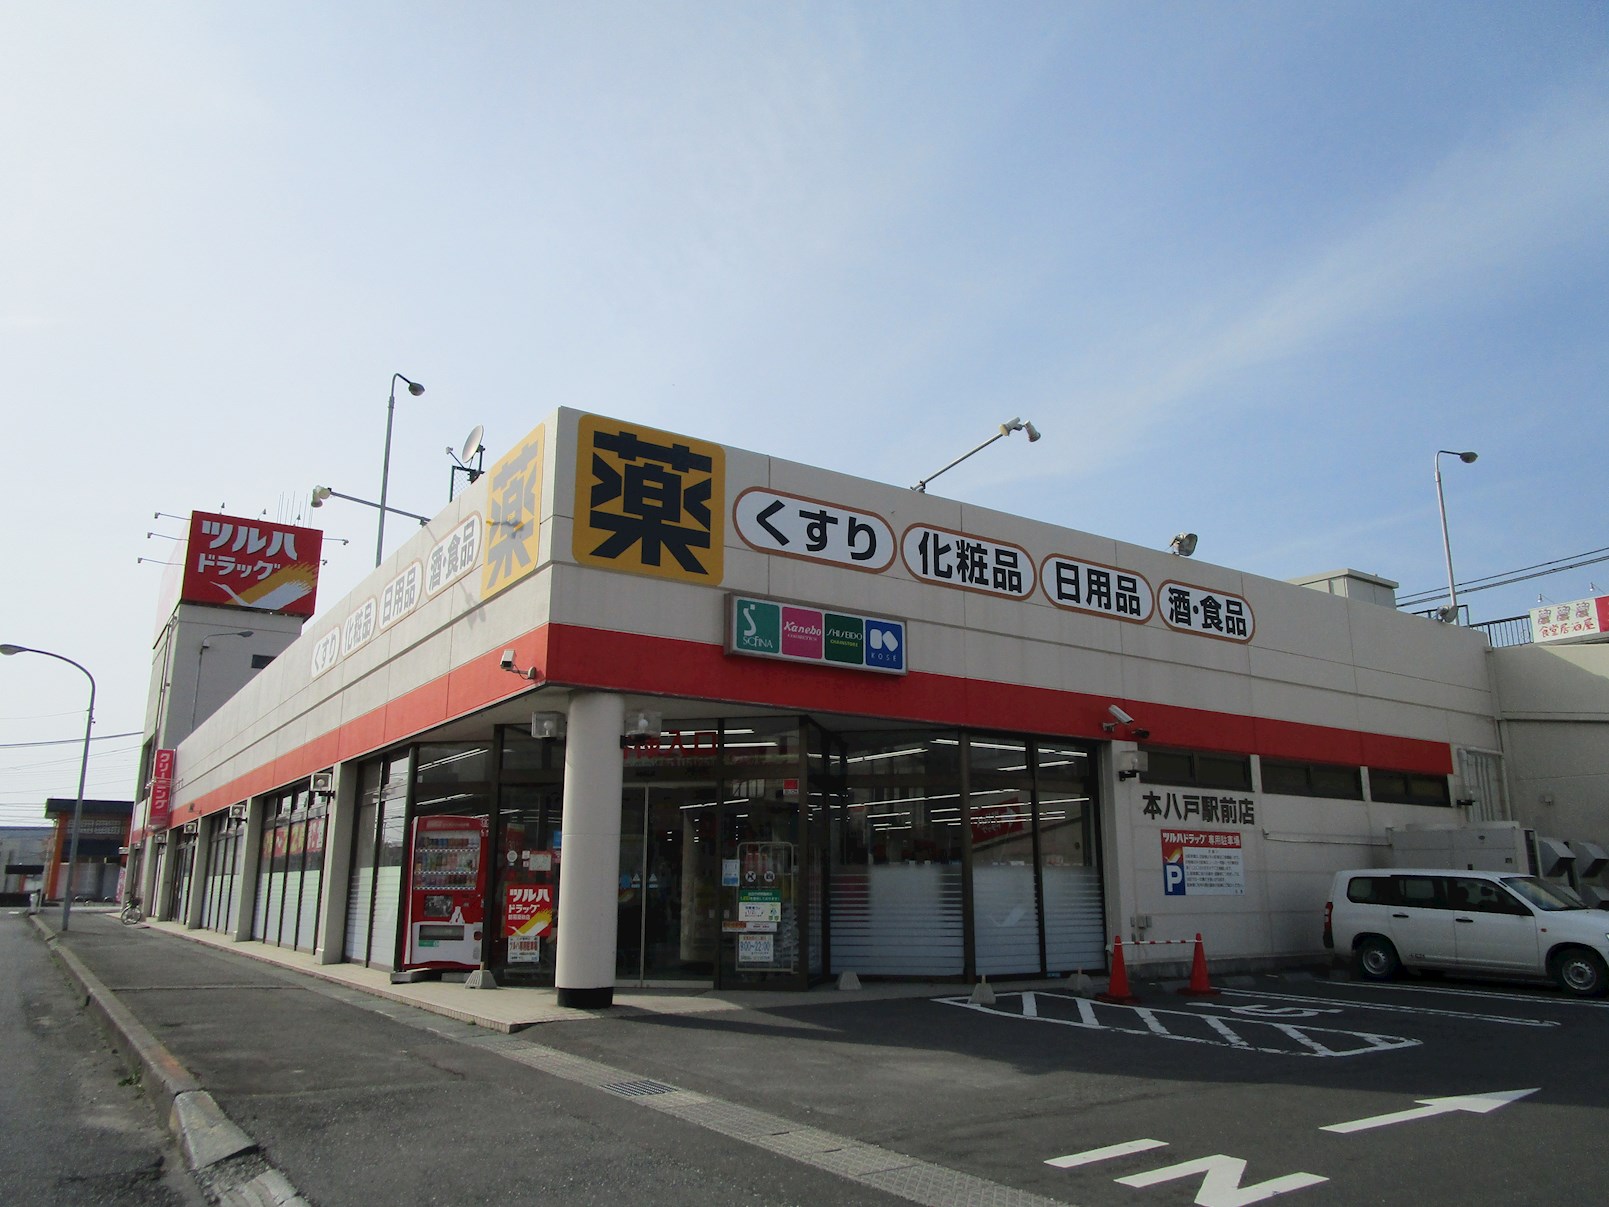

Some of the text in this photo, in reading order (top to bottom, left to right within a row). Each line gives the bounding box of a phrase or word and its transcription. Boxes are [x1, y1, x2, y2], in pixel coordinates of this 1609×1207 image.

[486, 441, 539, 589] 薬
[589, 430, 712, 575] 薬
[201, 520, 298, 560] ツルハ
[756, 499, 877, 560] くすり
[198, 553, 281, 580] ドラッグ
[918, 531, 1022, 594] 化粧品
[382, 567, 416, 625] 日用品
[1055, 561, 1141, 616] 日用品
[344, 602, 372, 653] 化粧品
[743, 635, 774, 648] SOFINA
[783, 621, 822, 637] Kanebo
[826, 628, 863, 641] SHISEIDO
[313, 632, 337, 671] くすり
[155, 752, 169, 809] クリーニング
[1142, 791, 1255, 825] 本八戸駅前店
[1162, 832, 1205, 845] ツルハドラッグ
[508, 904, 540, 914] ドラッグ
[509, 888, 550, 902] ツルハ
